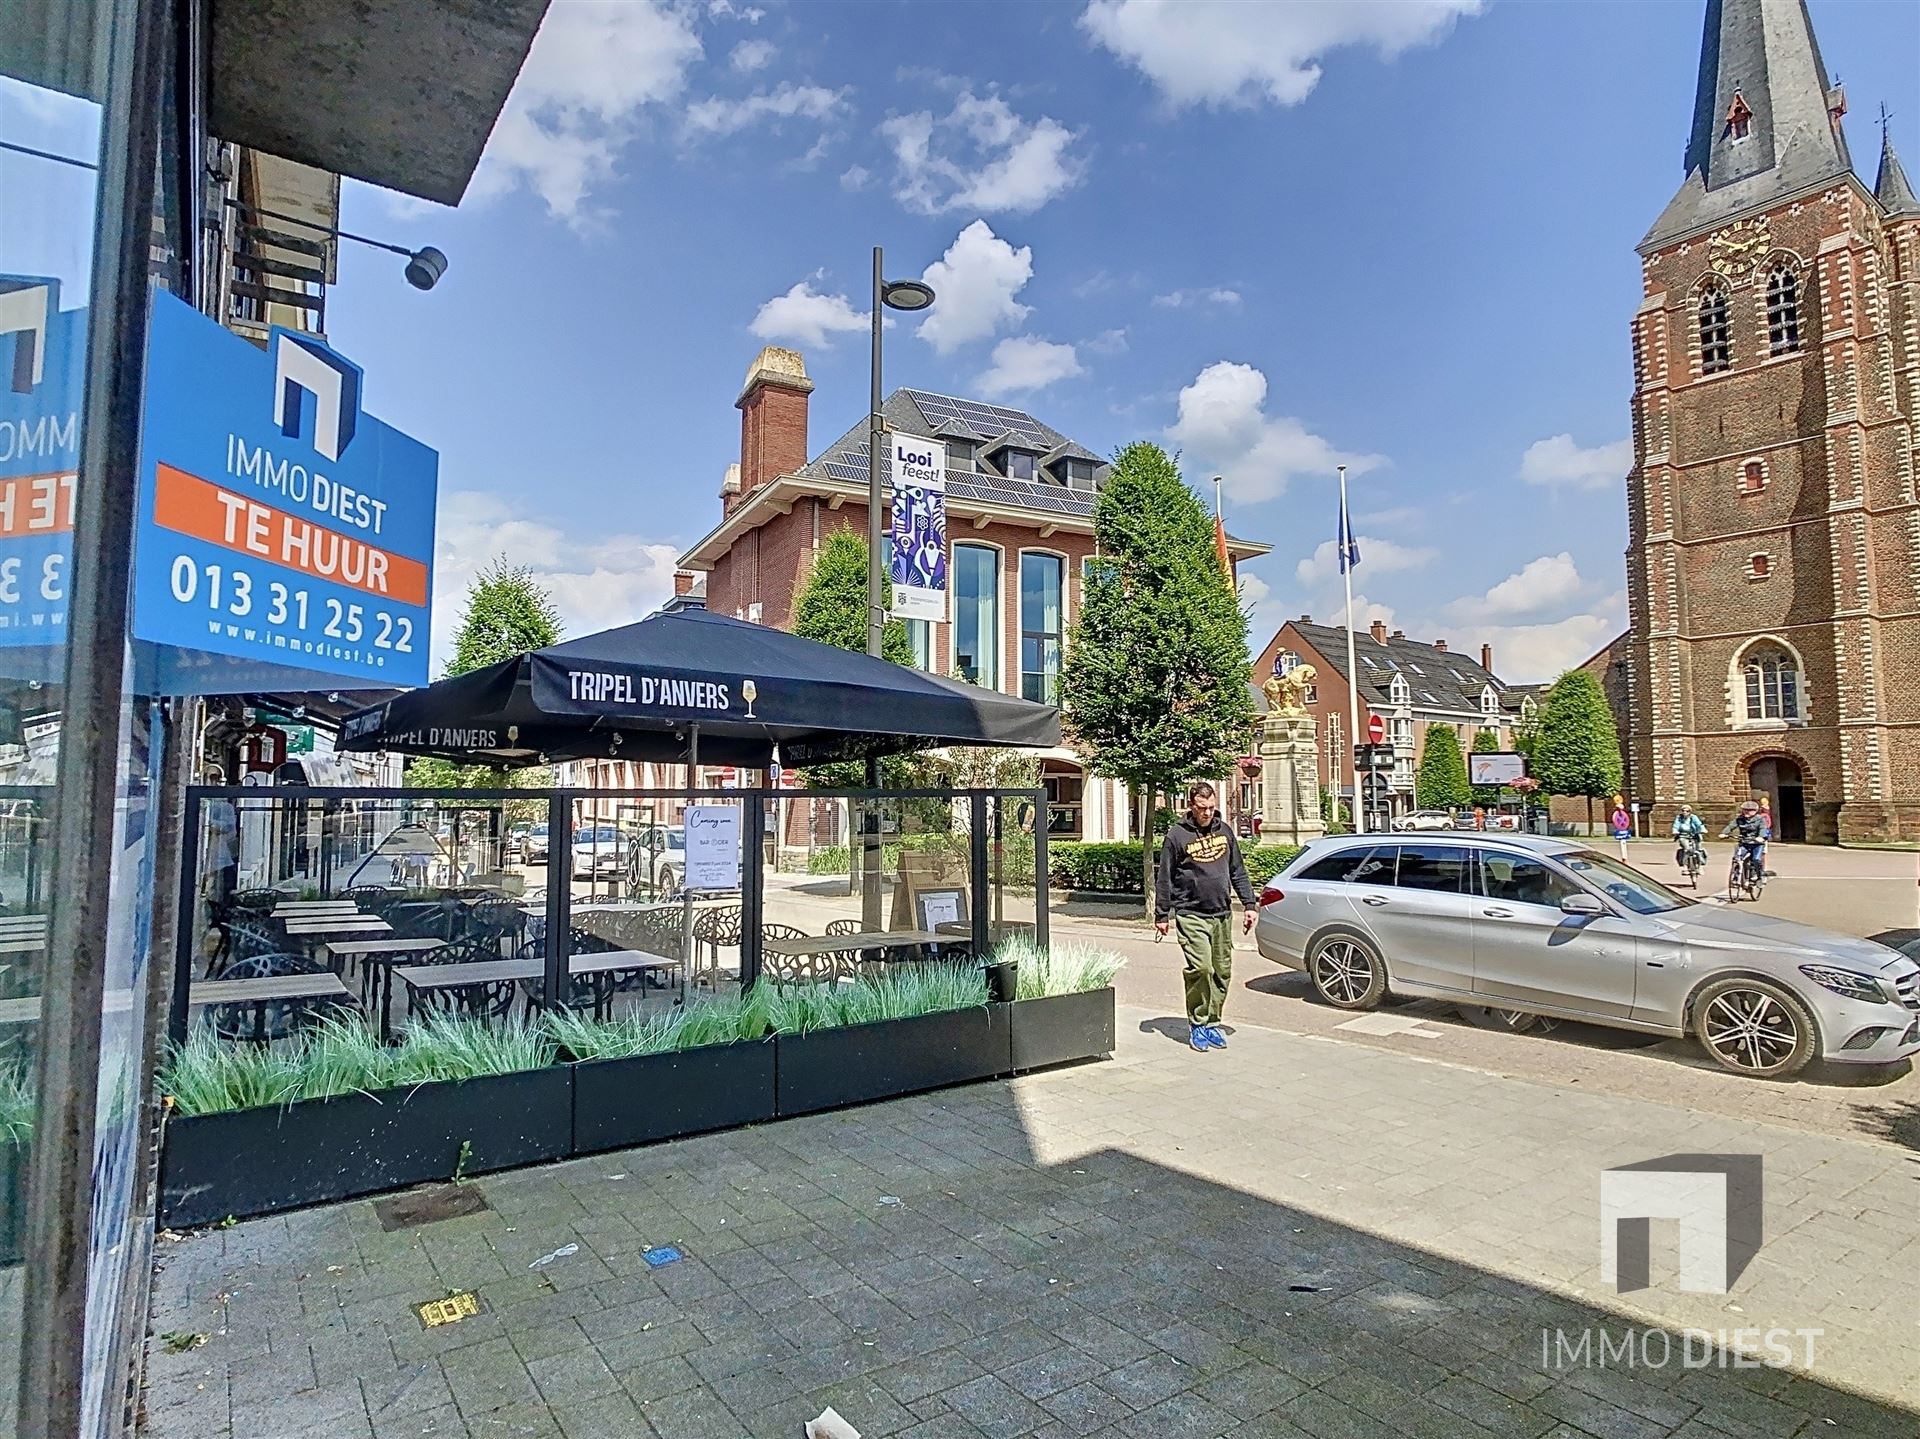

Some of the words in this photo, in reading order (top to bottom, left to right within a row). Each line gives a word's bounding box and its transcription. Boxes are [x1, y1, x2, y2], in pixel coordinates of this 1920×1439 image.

[897, 446, 932, 468] Looi
[901, 463, 940, 483] feest!
[227, 434, 308, 502] IMMO
[312, 474, 387, 534] DIEST
[217, 491, 271, 554] TE
[281, 517, 389, 593] HUUR
[171, 555, 252, 616] 013
[267, 582, 309, 630] 31
[324, 599, 364, 642] 25
[374, 612, 413, 653] 22
[208, 620, 385, 667] www.immodiest.be
[568, 671, 637, 704] TRIPEL
[641, 676, 730, 710] D'ANVERS
[429, 728, 497, 747] D'ANVERS
